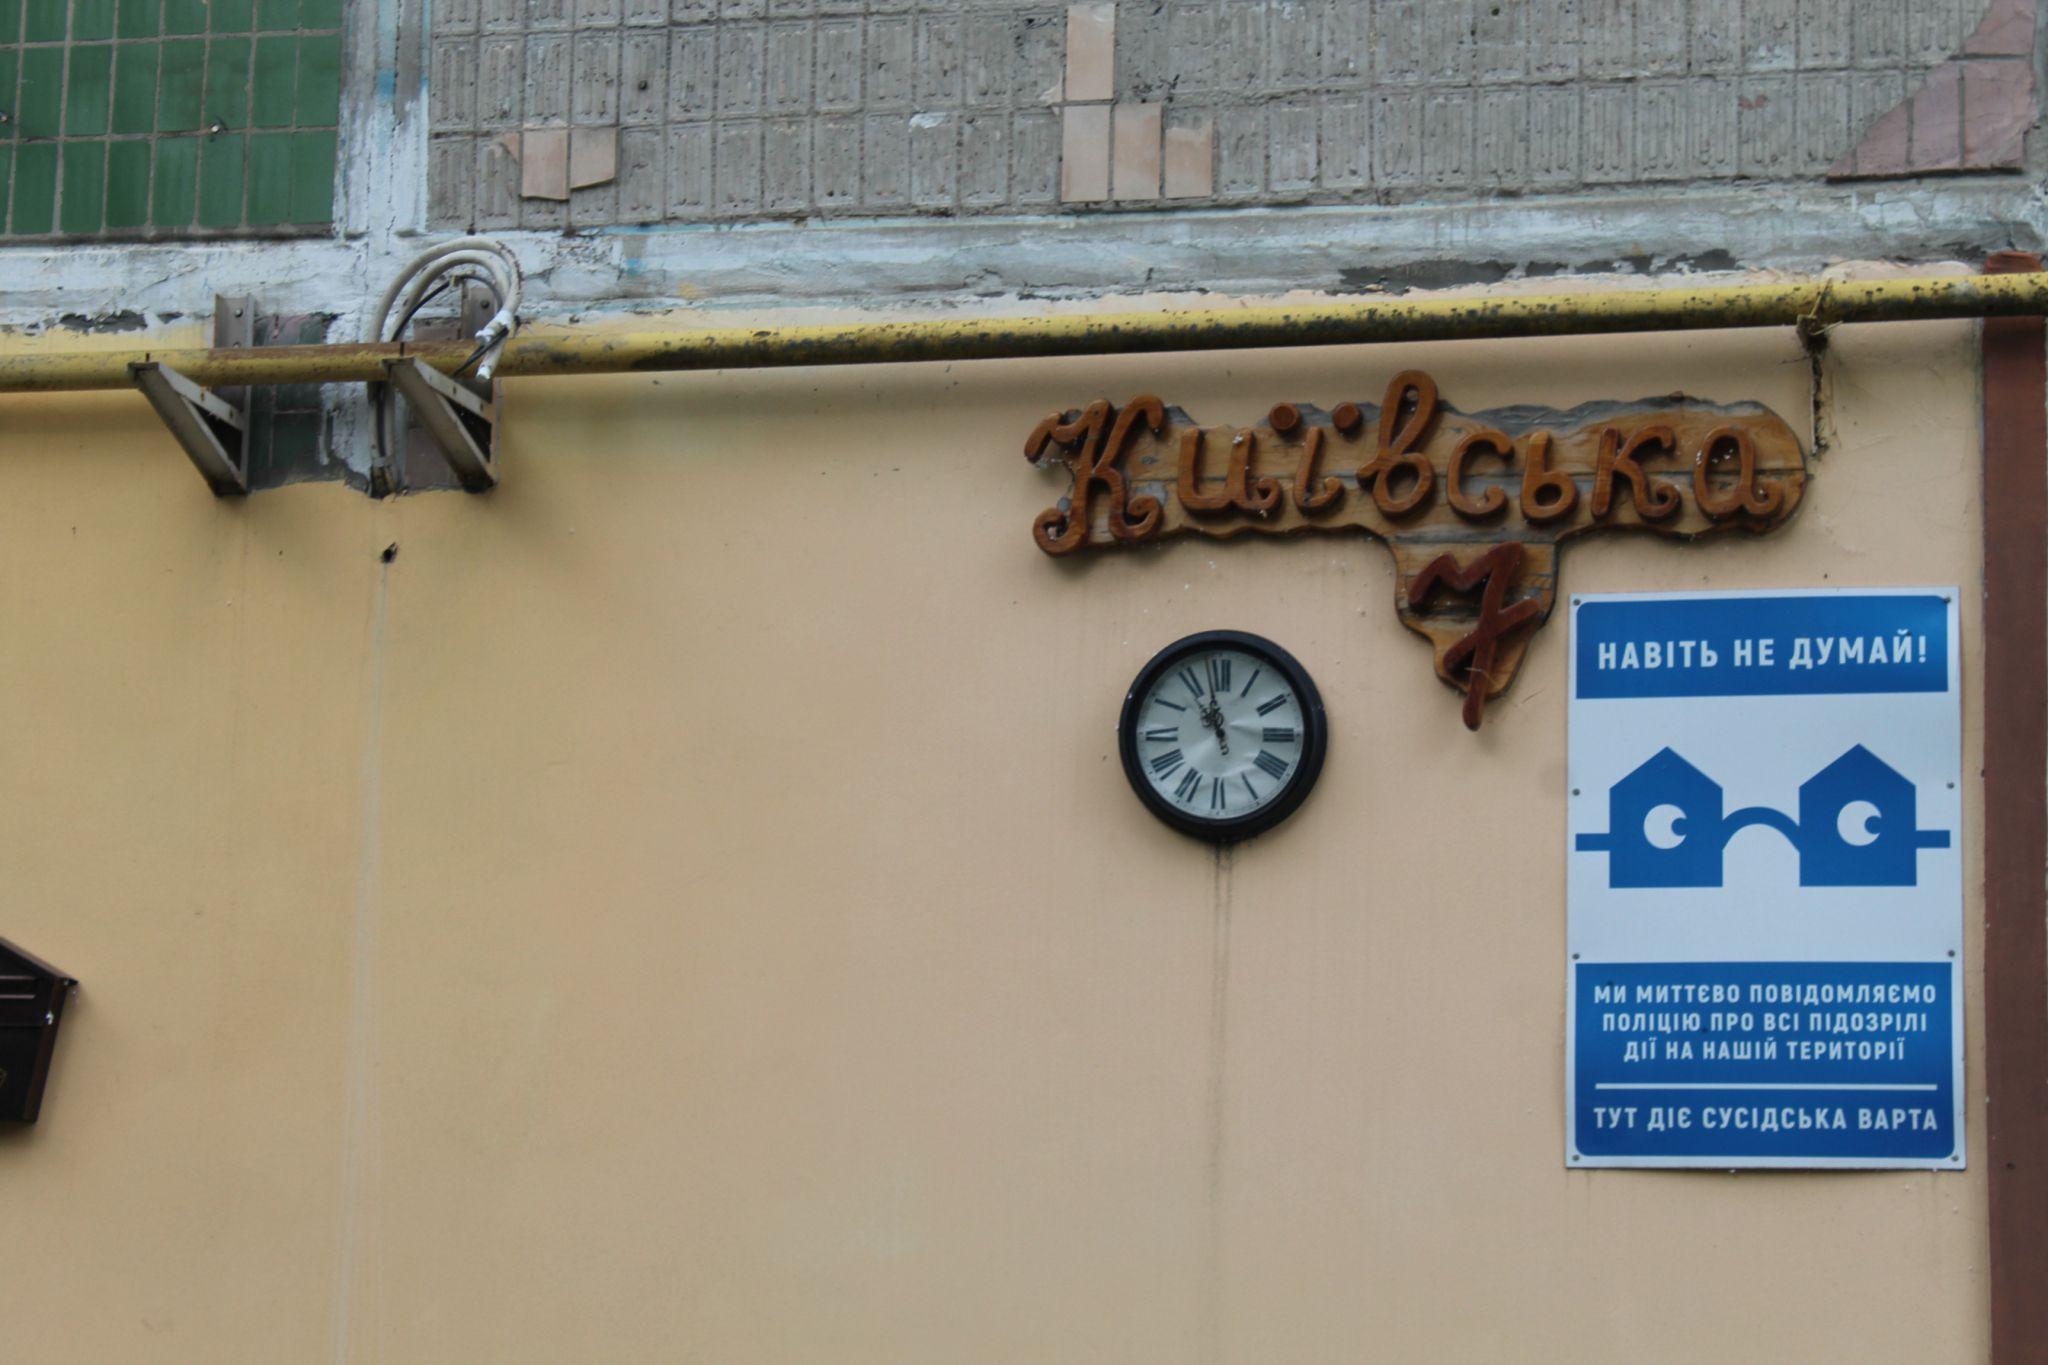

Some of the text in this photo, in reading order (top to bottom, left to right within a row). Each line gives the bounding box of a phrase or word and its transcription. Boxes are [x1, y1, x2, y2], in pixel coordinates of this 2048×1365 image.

[1024, 369, 1786, 556] Київська
[1408, 541, 1540, 731] 7
[1598, 628, 1927, 670] НАВІТЬ НЕ ДУМАЙ!
[1594, 984, 1937, 1006] МИ МИТТЄВО ПОВІДОМЛЯЄМО
[1602, 1012, 1927, 1034] ПОЛІЦІЮ ПРО ВСІ ПІДОЗРІЛІ
[1623, 1036, 1905, 1063] ДІЇ НА НАШІЙ ТЕРИТОРІЇ
[1593, 1107, 1938, 1132] ТУТ ДІЄ СУСІДСЬКА ВАРТА
